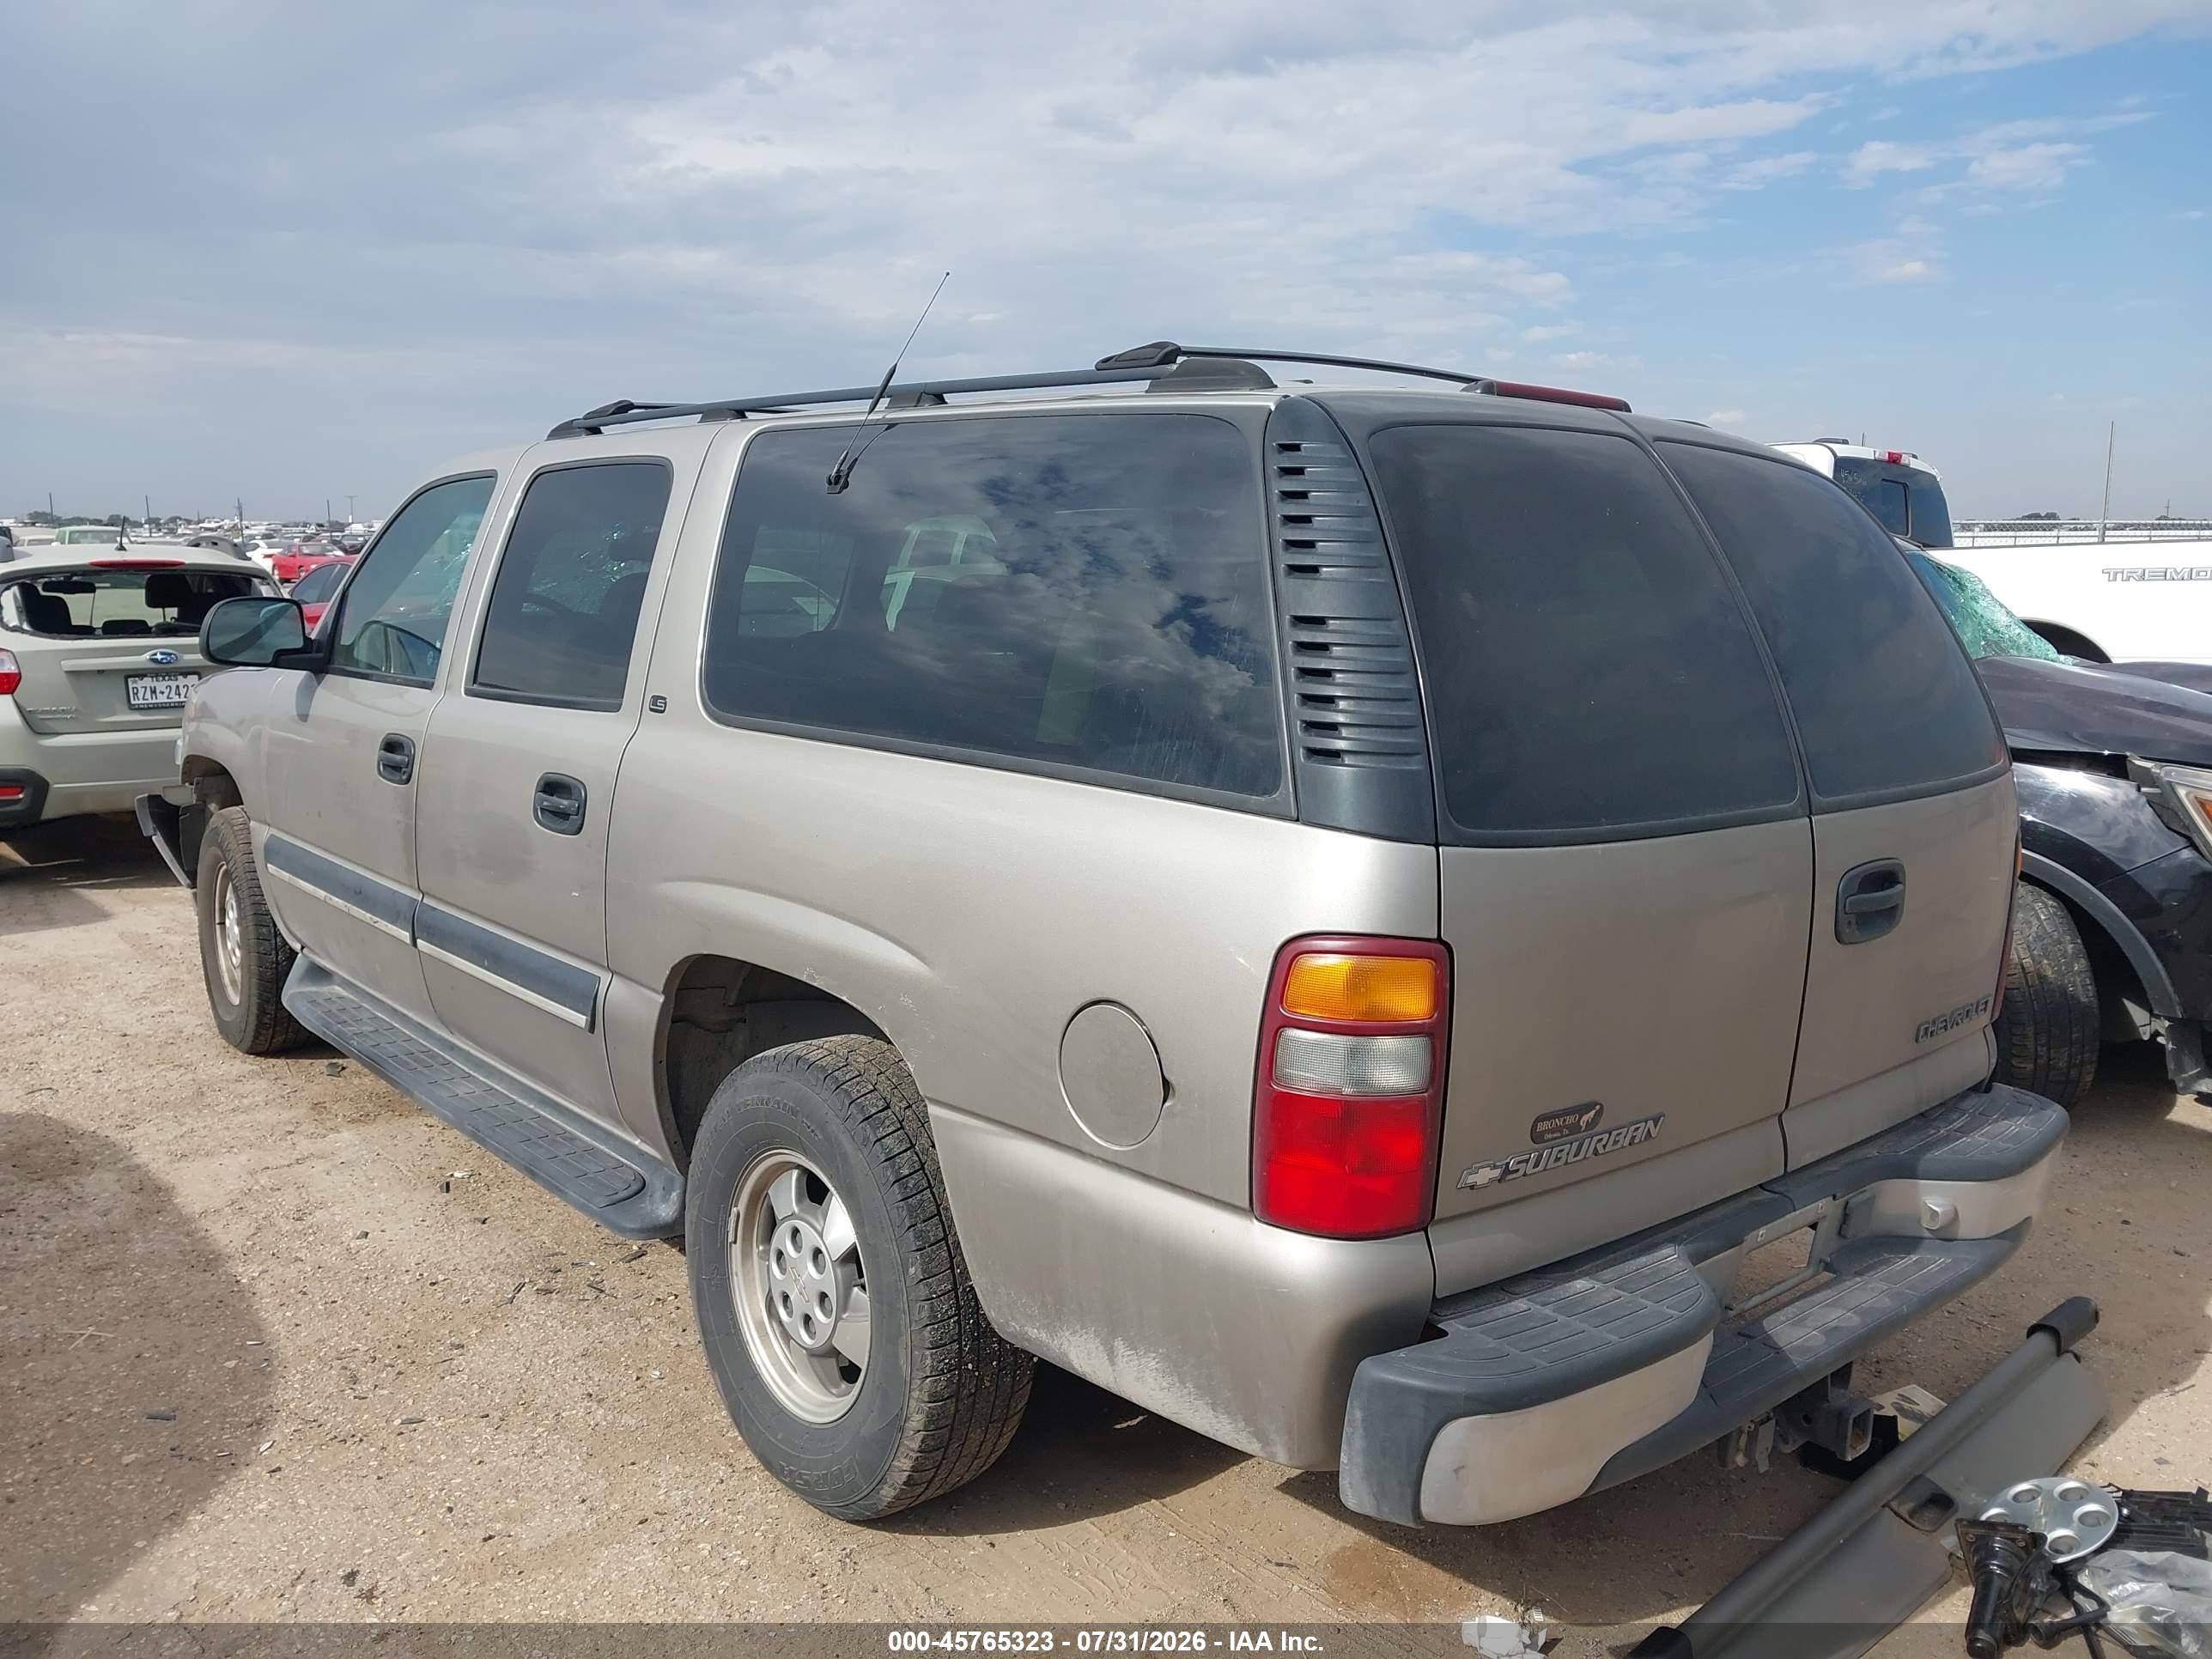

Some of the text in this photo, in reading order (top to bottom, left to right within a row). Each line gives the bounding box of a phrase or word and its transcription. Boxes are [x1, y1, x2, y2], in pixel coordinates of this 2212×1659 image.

[2102, 568, 2212, 582] TREMO
[650, 697, 665, 710] LS
[1536, 1113, 1580, 1132] BRONCHO
[1506, 1115, 1664, 1182] SUBURBAN
